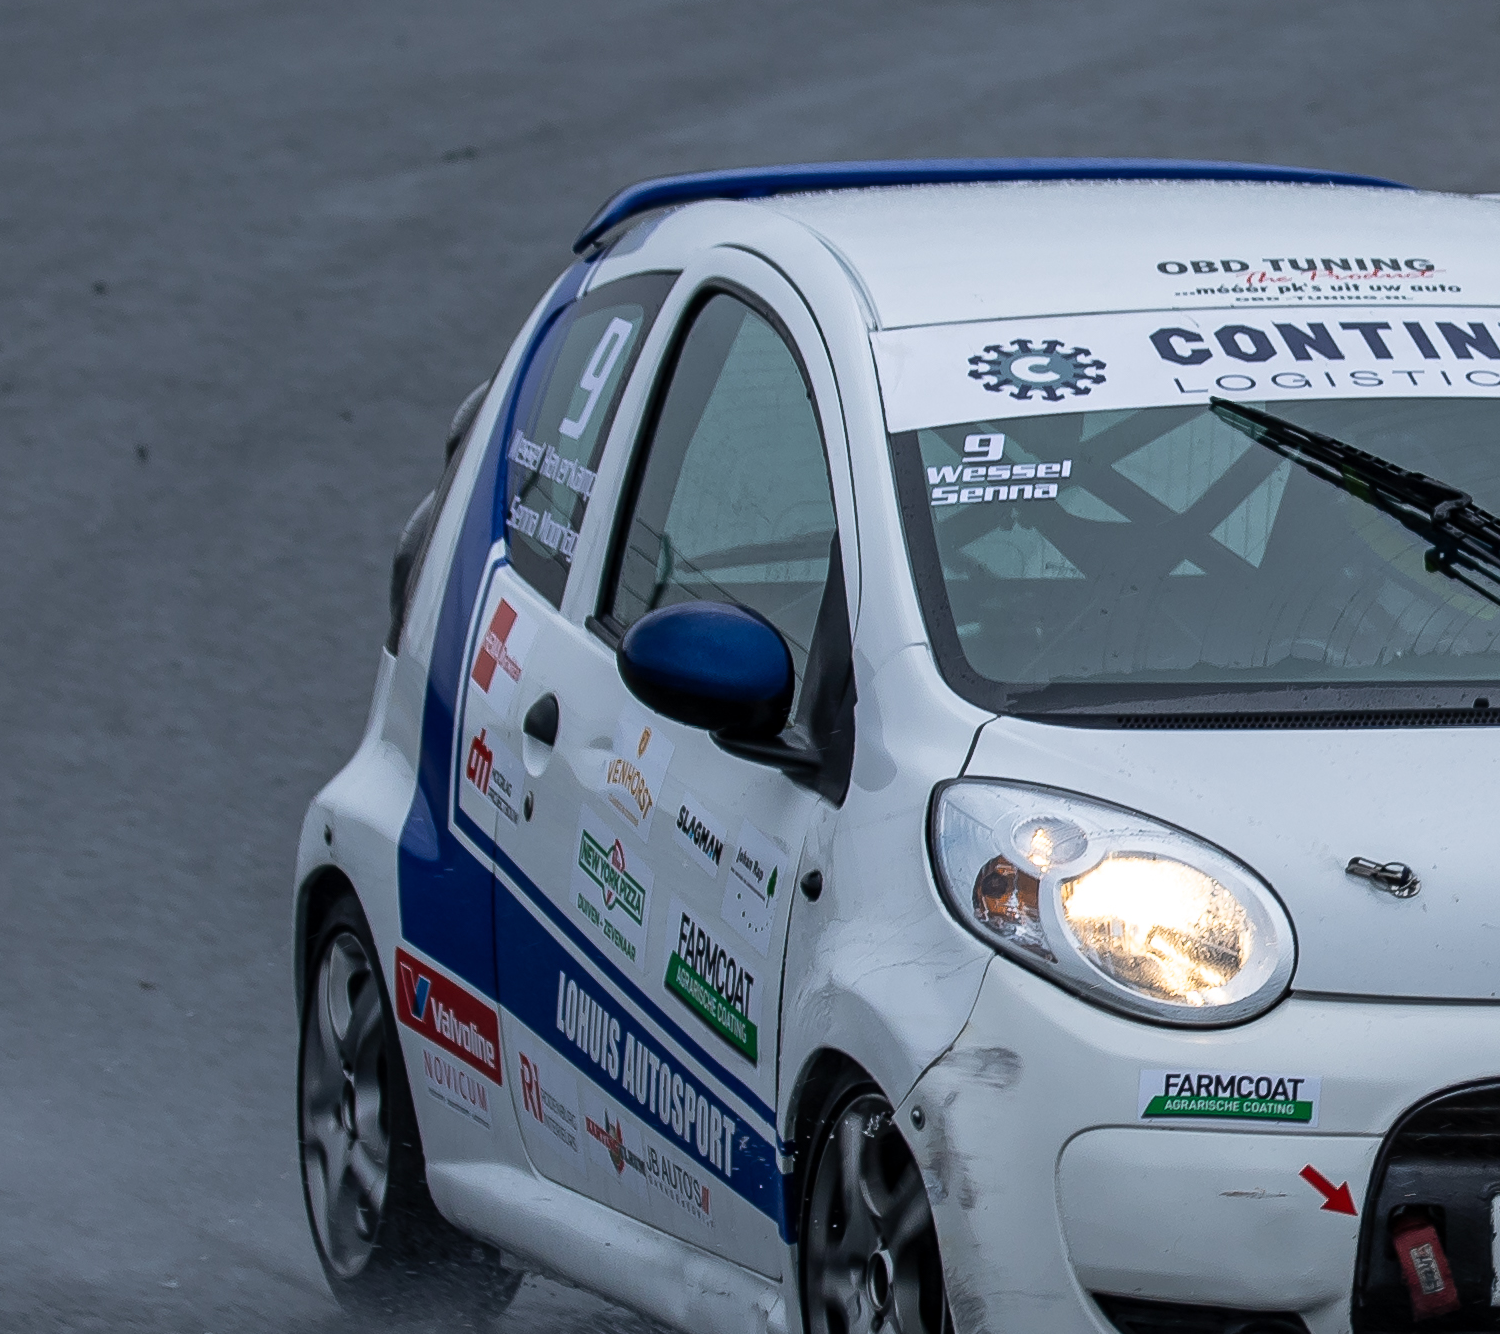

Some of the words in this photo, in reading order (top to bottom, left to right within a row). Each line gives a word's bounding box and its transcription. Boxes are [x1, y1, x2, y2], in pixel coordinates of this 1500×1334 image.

[1156, 259, 1250, 275] OBD
[1262, 257, 1436, 273] TUNING
[1278, 281, 1322, 295] pk's
[1330, 281, 1361, 293] uit
[1368, 283, 1402, 293] uw
[1410, 283, 1462, 293] auto
[559, 316, 633, 437] 9
[962, 433, 1005, 463] 9
[927, 460, 1072, 485] Wessel
[931, 483, 1058, 506] Senna
[607, 758, 652, 819] VENHORST
[676, 805, 724, 866] SLAGMAN
[580, 840, 600, 873] NEW
[600, 858, 621, 893] YORK
[619, 877, 642, 915] PIZZA
[677, 911, 755, 1020] FARMCOAT
[430, 995, 497, 1070] Valvoline
[717, 1002, 748, 1045] COATING
[423, 1048, 488, 1113] NOVICUM
[556, 970, 621, 1081] LOHUIS
[622, 1031, 736, 1179] AUTOSPORT
[1163, 1073, 1305, 1102] FARMCOAT
[1164, 1099, 1240, 1113] AGRARISCHE
[1243, 1101, 1295, 1115] COATING
[646, 1146, 660, 1177] JB
